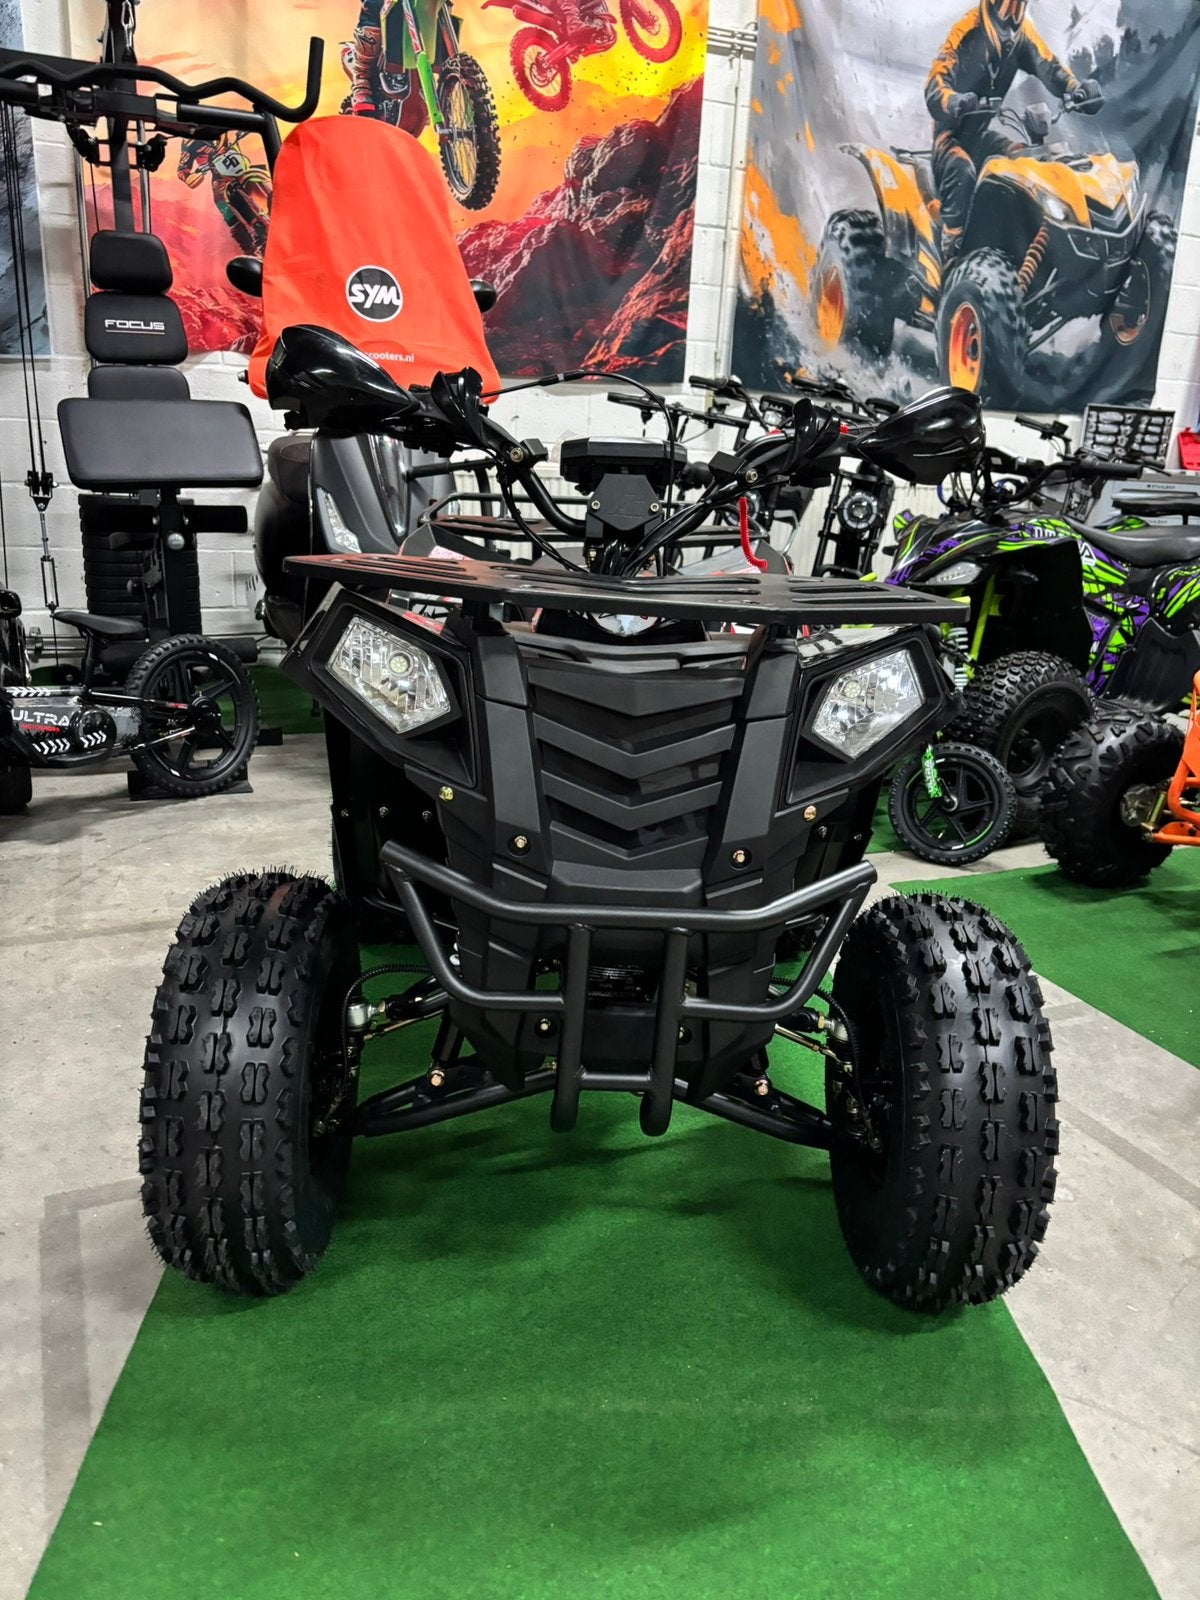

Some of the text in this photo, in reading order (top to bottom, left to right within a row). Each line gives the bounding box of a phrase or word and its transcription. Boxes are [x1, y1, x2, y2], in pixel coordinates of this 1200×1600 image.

[349, 284, 401, 308] SYM
[105, 319, 165, 330] FOCUS
[366, 351, 415, 362] cooters.nl
[11, 708, 71, 727] ULTRA
